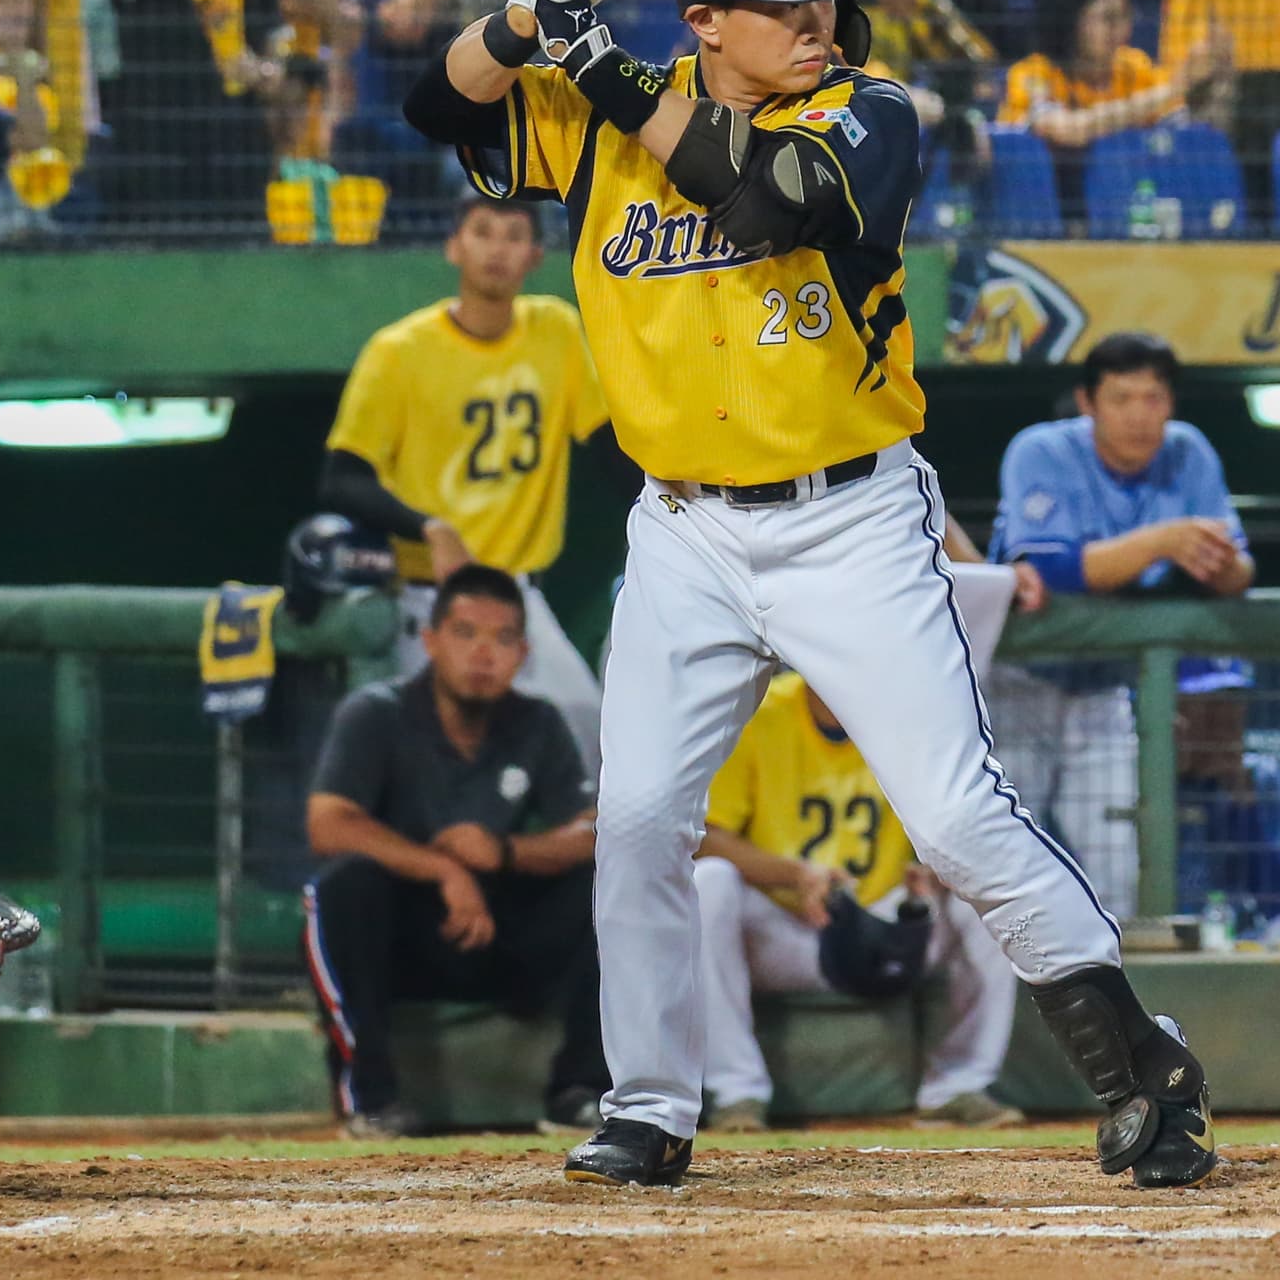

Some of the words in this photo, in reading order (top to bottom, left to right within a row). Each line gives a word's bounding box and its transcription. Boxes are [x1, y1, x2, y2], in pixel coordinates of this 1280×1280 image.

[757, 281, 832, 345] 23
[464, 391, 542, 481] 23
[799, 796, 878, 877] 23
